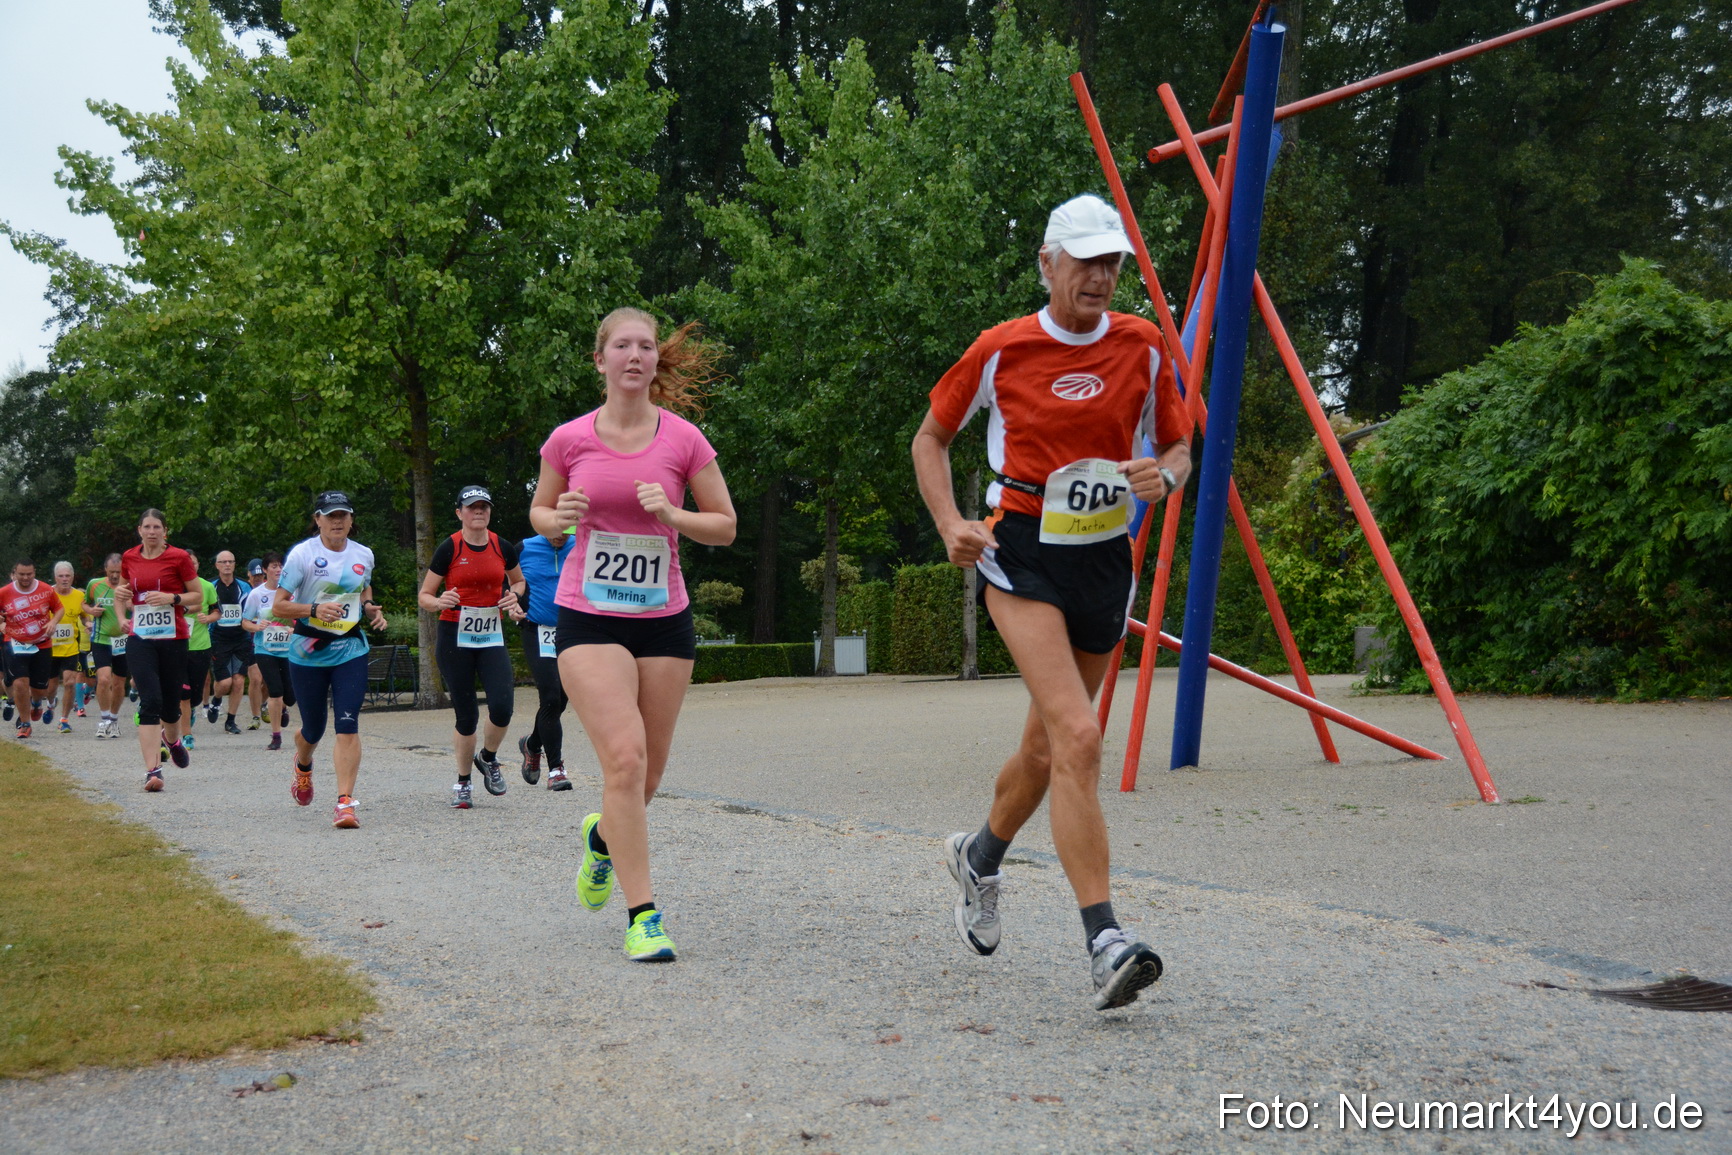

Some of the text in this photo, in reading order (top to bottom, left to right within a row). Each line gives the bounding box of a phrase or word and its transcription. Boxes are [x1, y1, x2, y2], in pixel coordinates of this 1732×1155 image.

[462, 489, 492, 500] adidas
[1068, 480, 1127, 511] 605
[1067, 518, 1105, 534] Martin
[625, 537, 665, 549] BOCK
[594, 551, 661, 584] 2201
[607, 589, 646, 604] Marina
[138, 611, 172, 626] 2035
[222, 609, 240, 618] 036
[463, 616, 498, 632] 2041
[55, 629, 71, 638] 130
[266, 632, 289, 642] 2467
[470, 635, 491, 643] Marion
